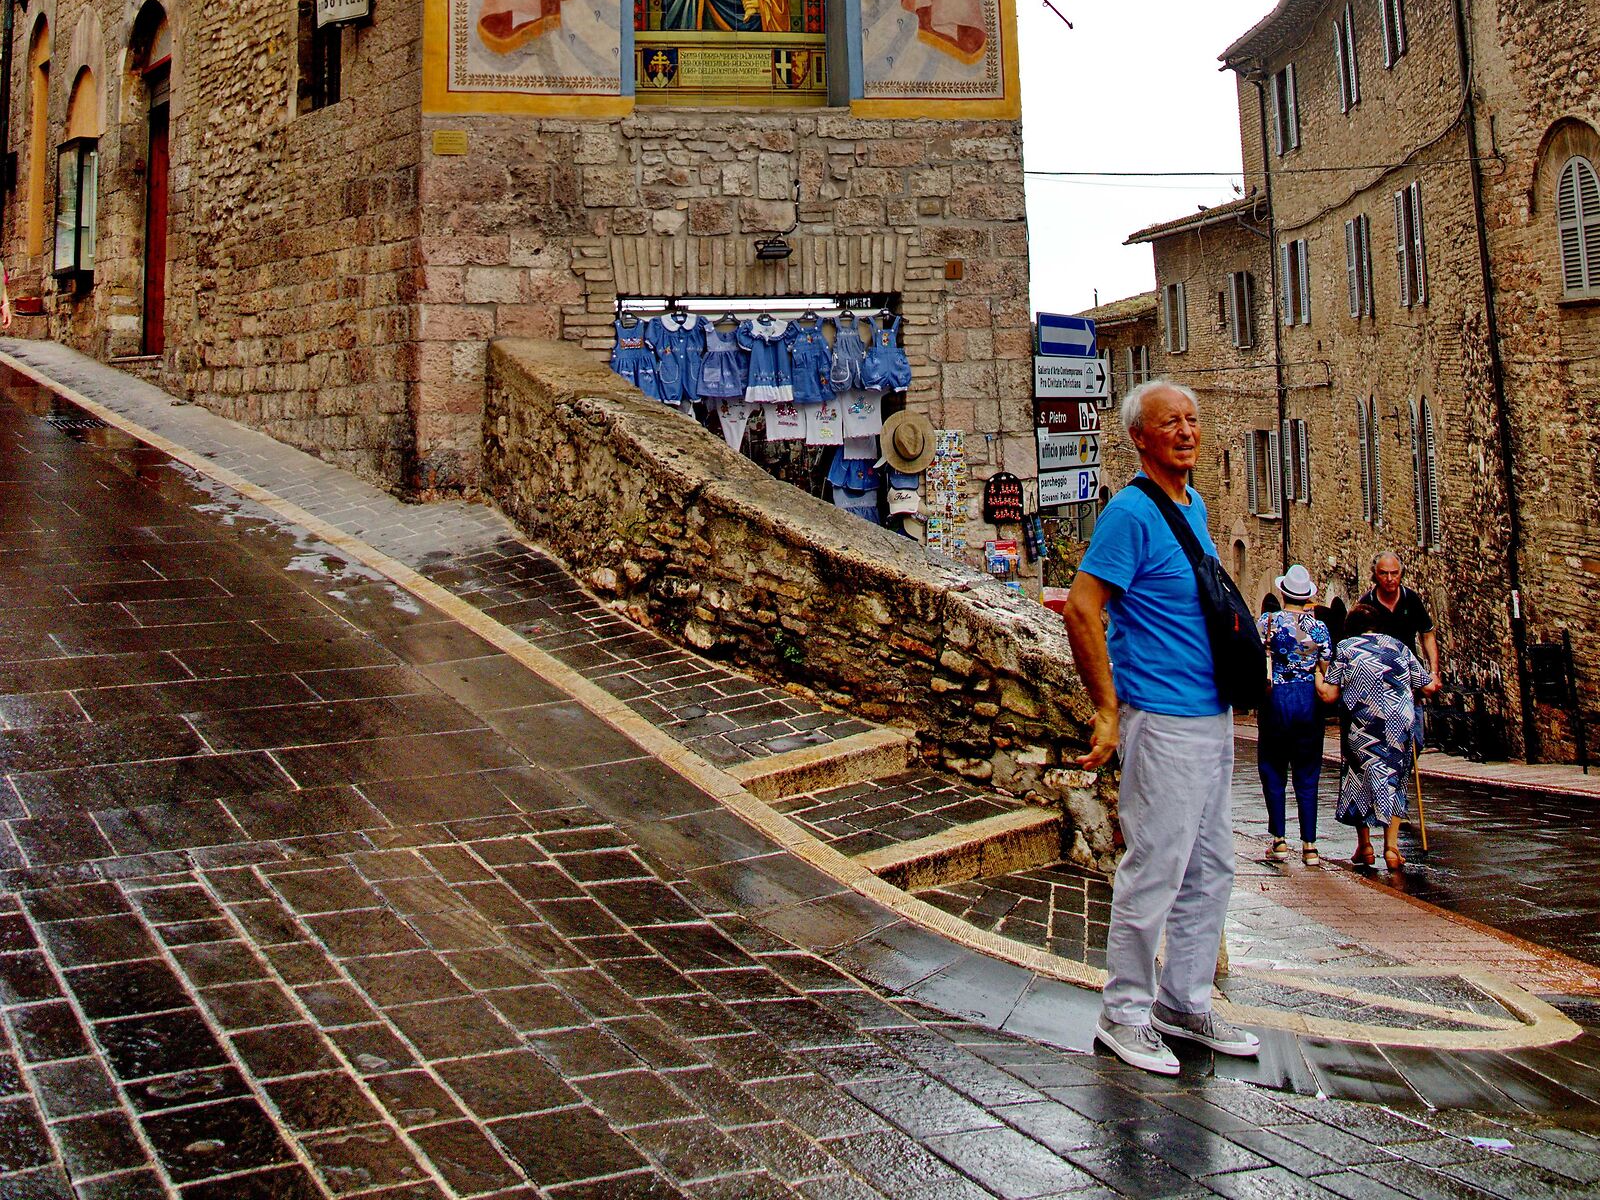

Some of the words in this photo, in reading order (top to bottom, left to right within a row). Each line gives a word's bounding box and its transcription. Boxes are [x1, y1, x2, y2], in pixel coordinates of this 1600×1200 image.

[1040, 411, 1047, 424] S.
[1049, 411, 1067, 424] Pietro
[1042, 443, 1058, 458] ufficio
[1059, 441, 1078, 460] postale
[1041, 475, 1067, 489] parcheggio
[1041, 492, 1059, 502] Giovanni
[1060, 491, 1071, 500] Paolo
